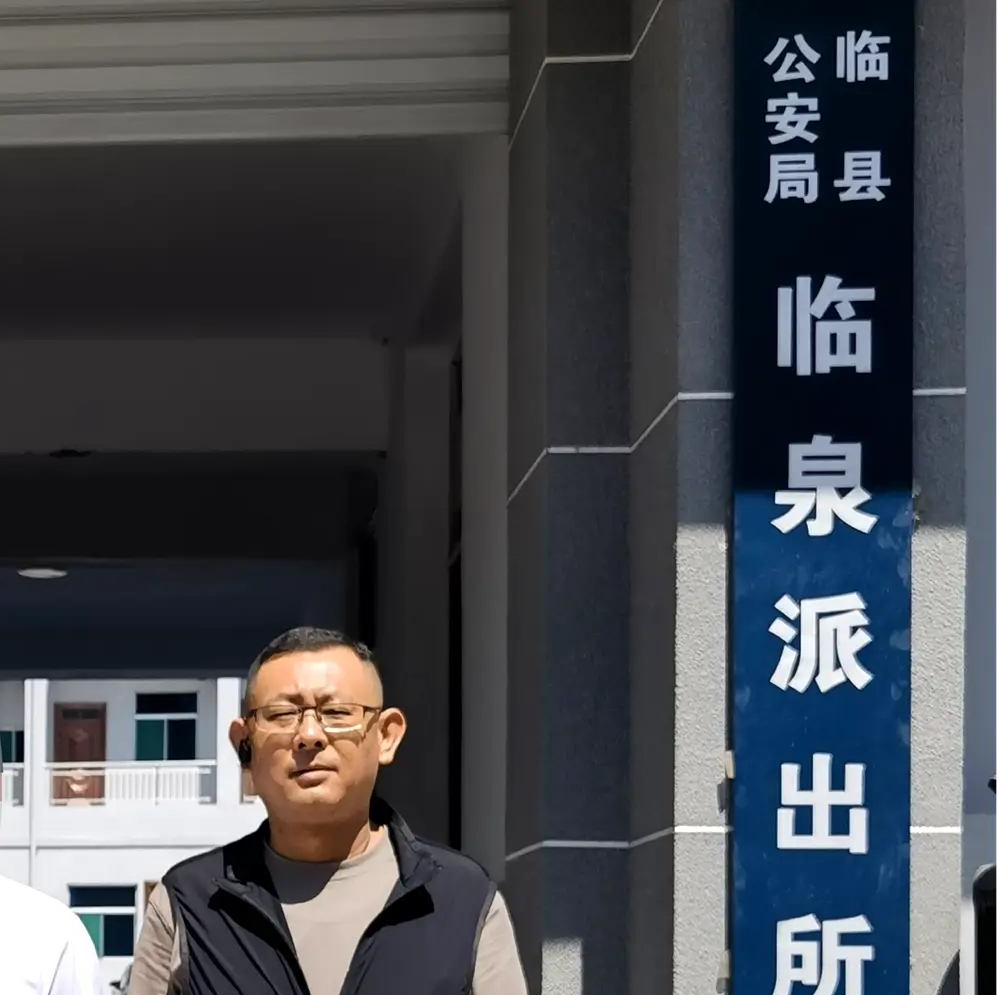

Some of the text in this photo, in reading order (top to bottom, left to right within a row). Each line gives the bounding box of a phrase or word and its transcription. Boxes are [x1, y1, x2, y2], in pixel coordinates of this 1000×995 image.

[763, 34, 821, 204] 公安局
[833, 30, 891, 202] 临县
